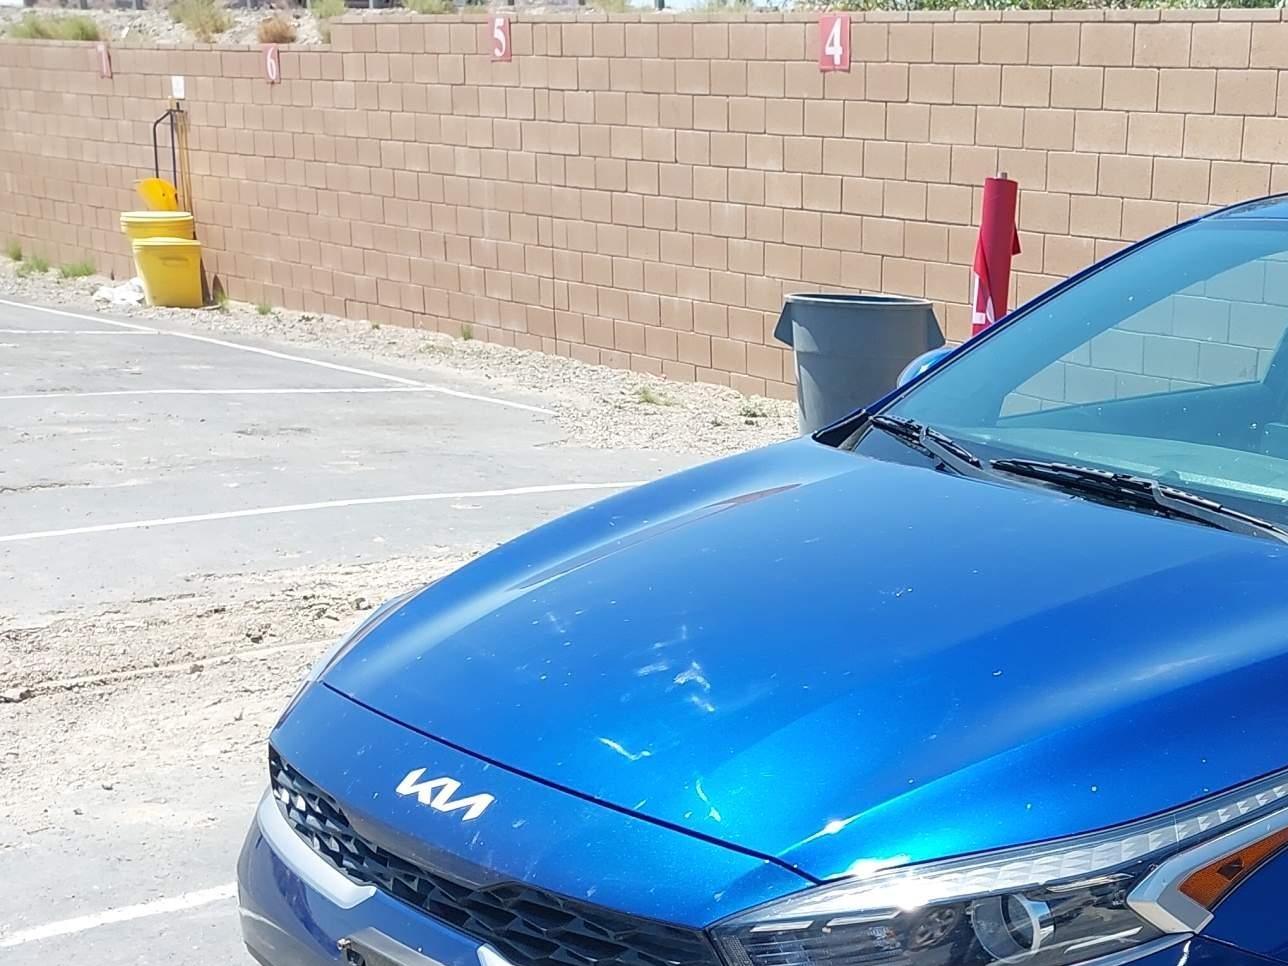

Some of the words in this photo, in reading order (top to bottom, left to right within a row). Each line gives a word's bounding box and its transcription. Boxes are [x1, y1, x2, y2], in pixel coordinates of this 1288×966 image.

[493, 17, 506, 58] 5
[824, 17, 843, 66] 4
[267, 46, 276, 80] 6
